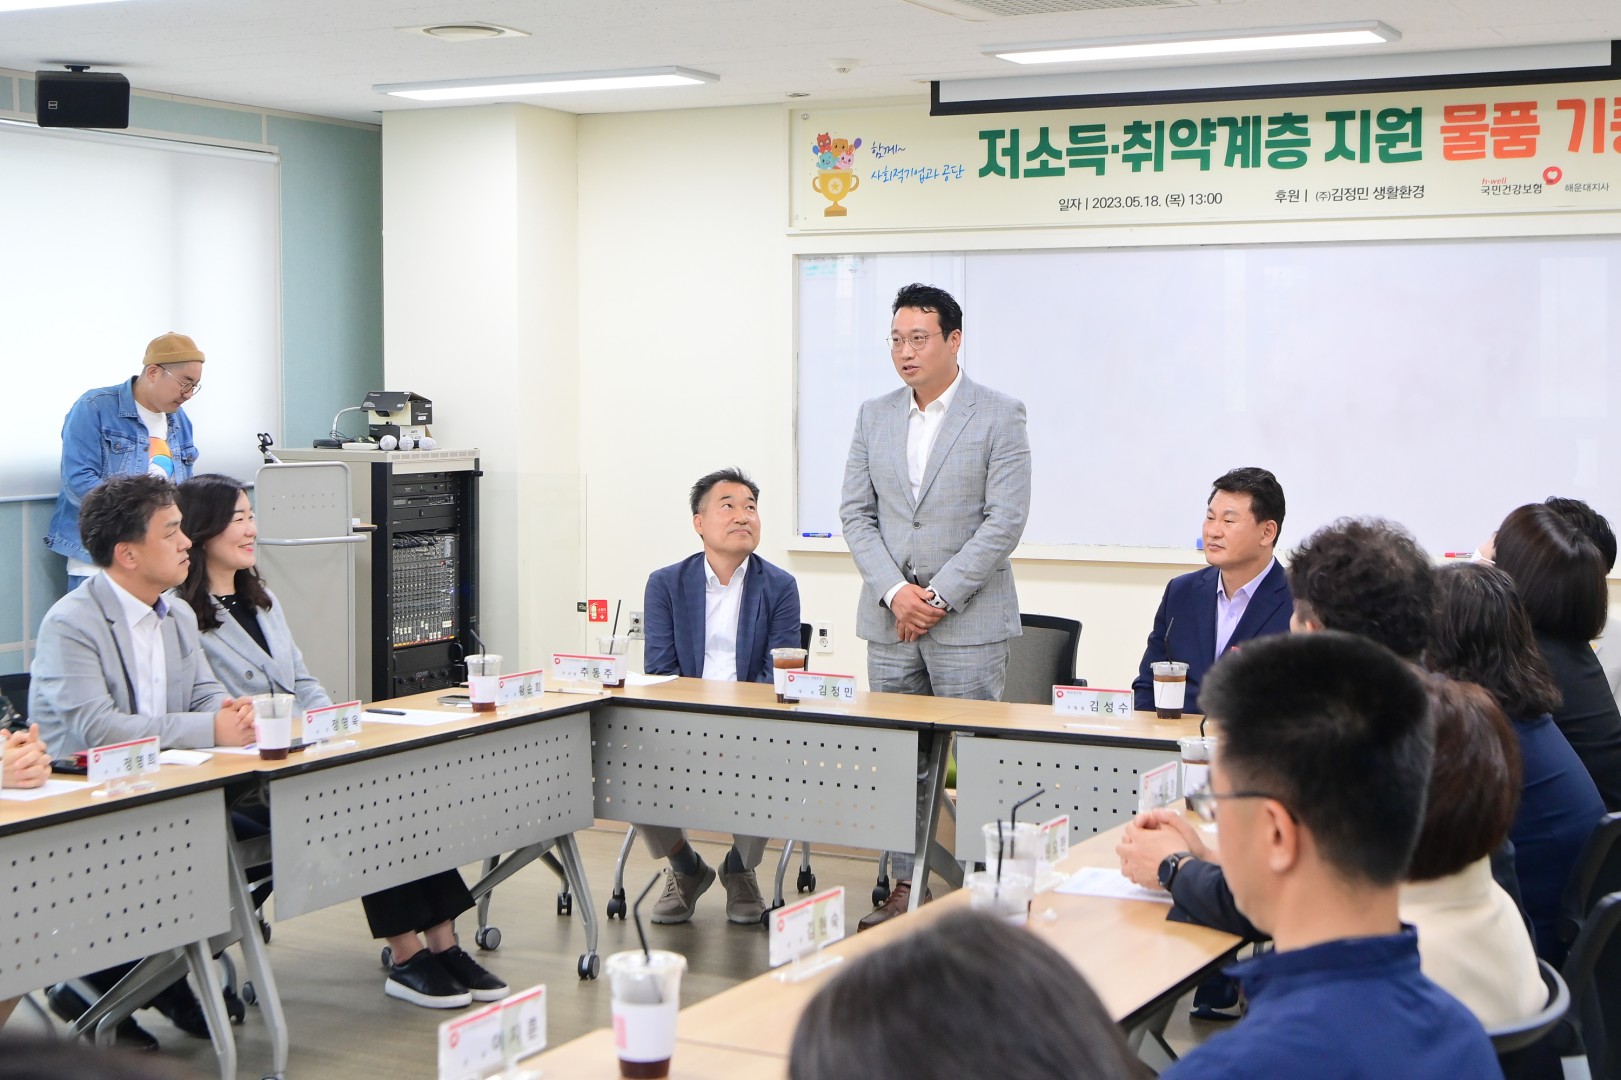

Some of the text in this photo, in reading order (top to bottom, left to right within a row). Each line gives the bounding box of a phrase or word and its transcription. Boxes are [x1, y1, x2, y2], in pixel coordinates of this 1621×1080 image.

[978, 96, 1621, 179] 저소득·취약계층 지원 물품 기
[870, 164, 965, 184] 사회적기업과 공단
[1274, 189, 1300, 203] 후원
[1372, 185, 1425, 200] 생활환경
[1481, 183, 1543, 196] 국민건강보험
[1564, 183, 1610, 193] 해운대지사
[1058, 192, 1223, 212] 일자 2023.05.18. (목) 13:00
[818, 684, 853, 698] 김정민
[1089, 700, 1129, 714] 김성수
